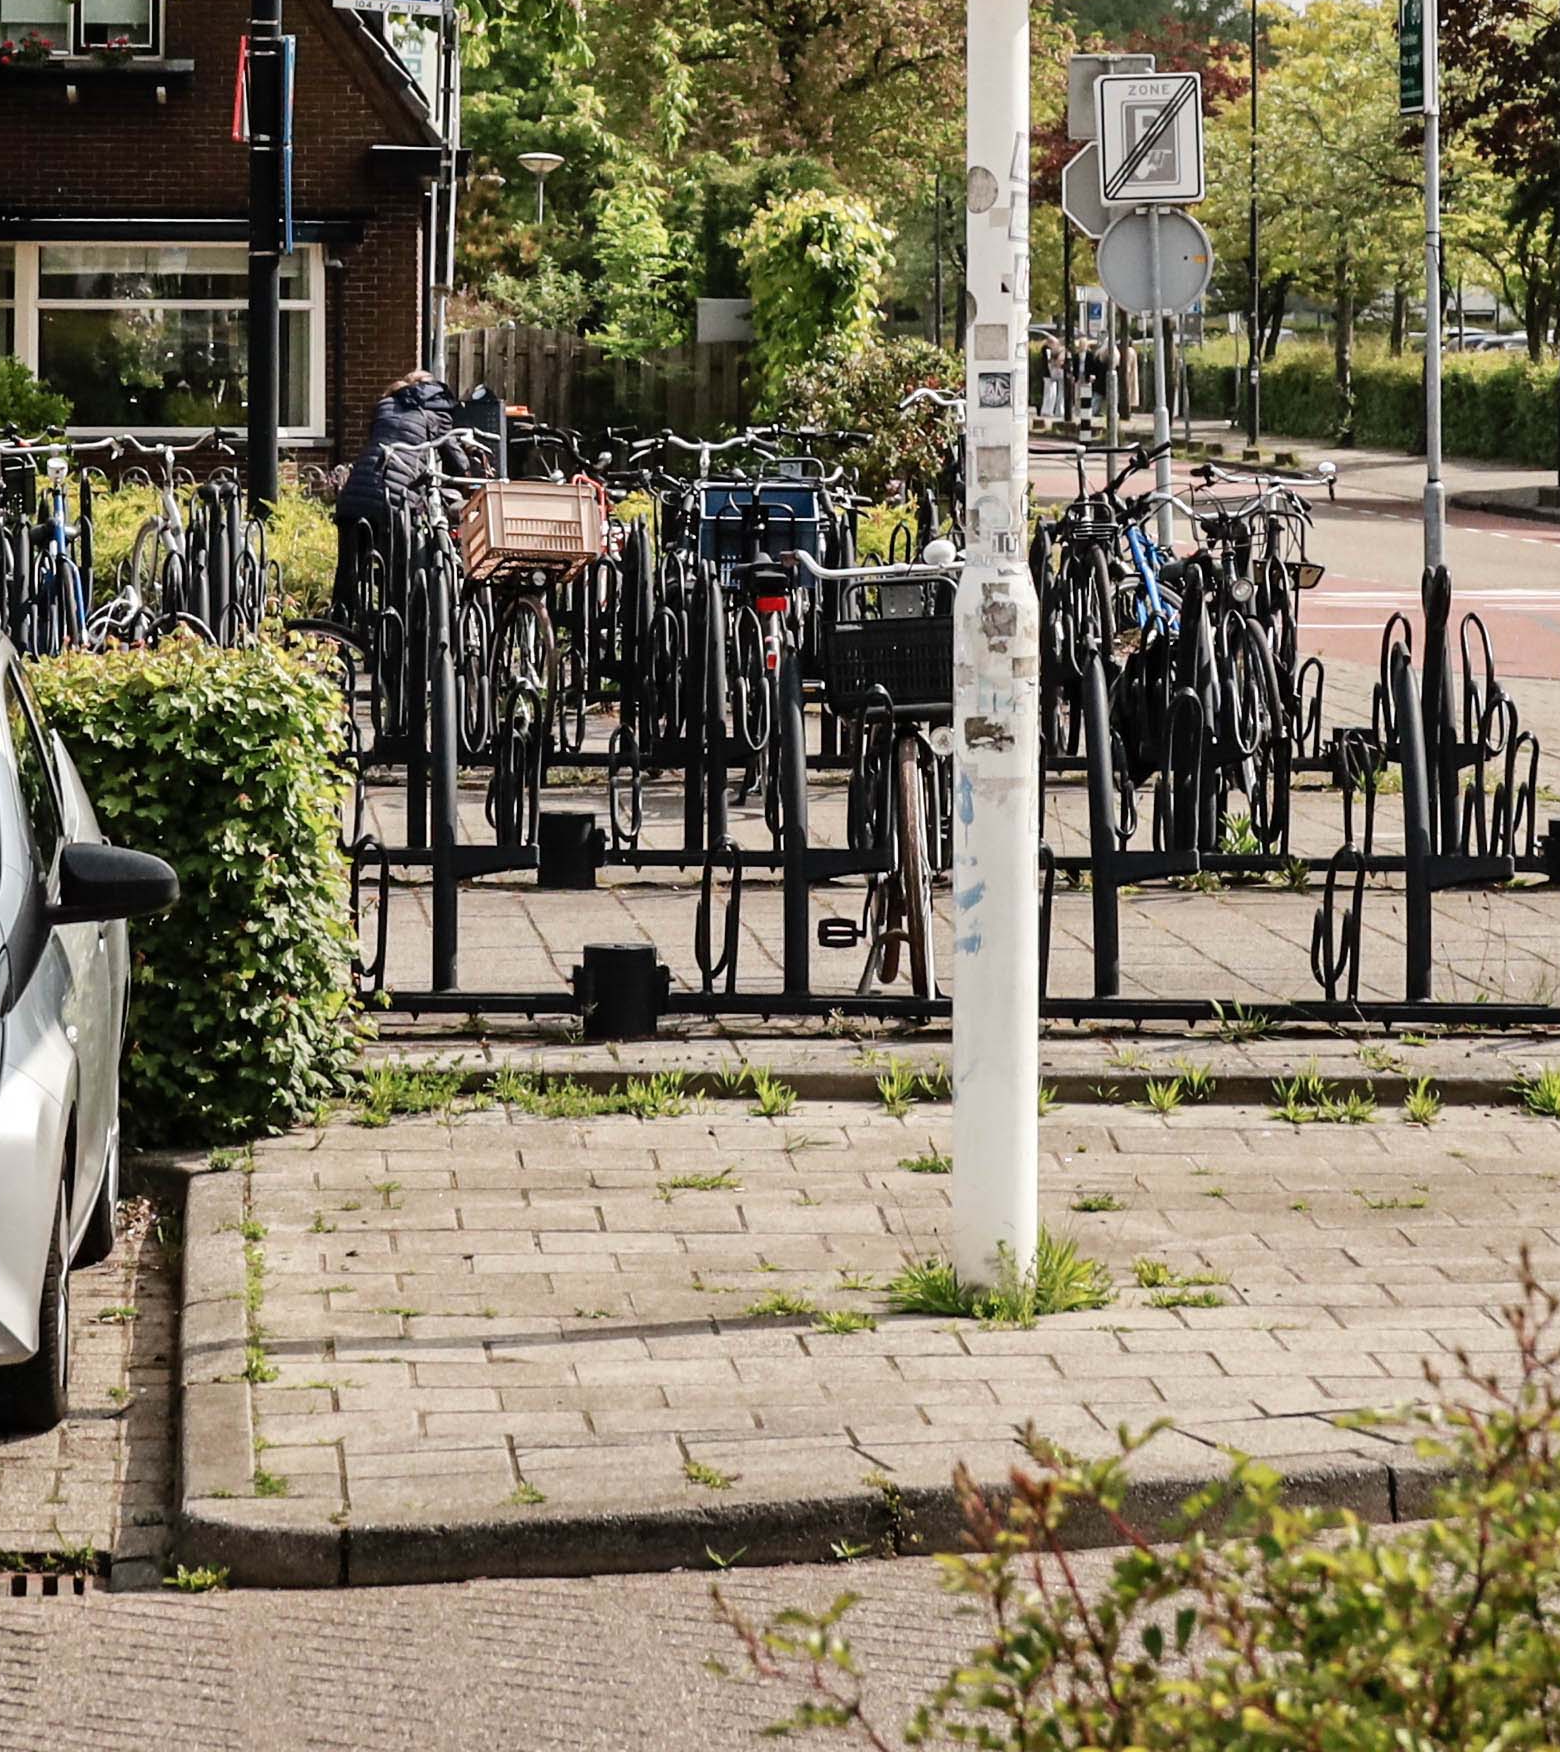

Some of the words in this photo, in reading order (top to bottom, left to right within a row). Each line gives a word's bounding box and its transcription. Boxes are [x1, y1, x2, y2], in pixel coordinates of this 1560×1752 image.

[355, 0, 372, 9] 104
[379, 1, 400, 11] t/m
[407, 4, 421, 12] 112
[1128, 84, 1171, 96] ZONE
